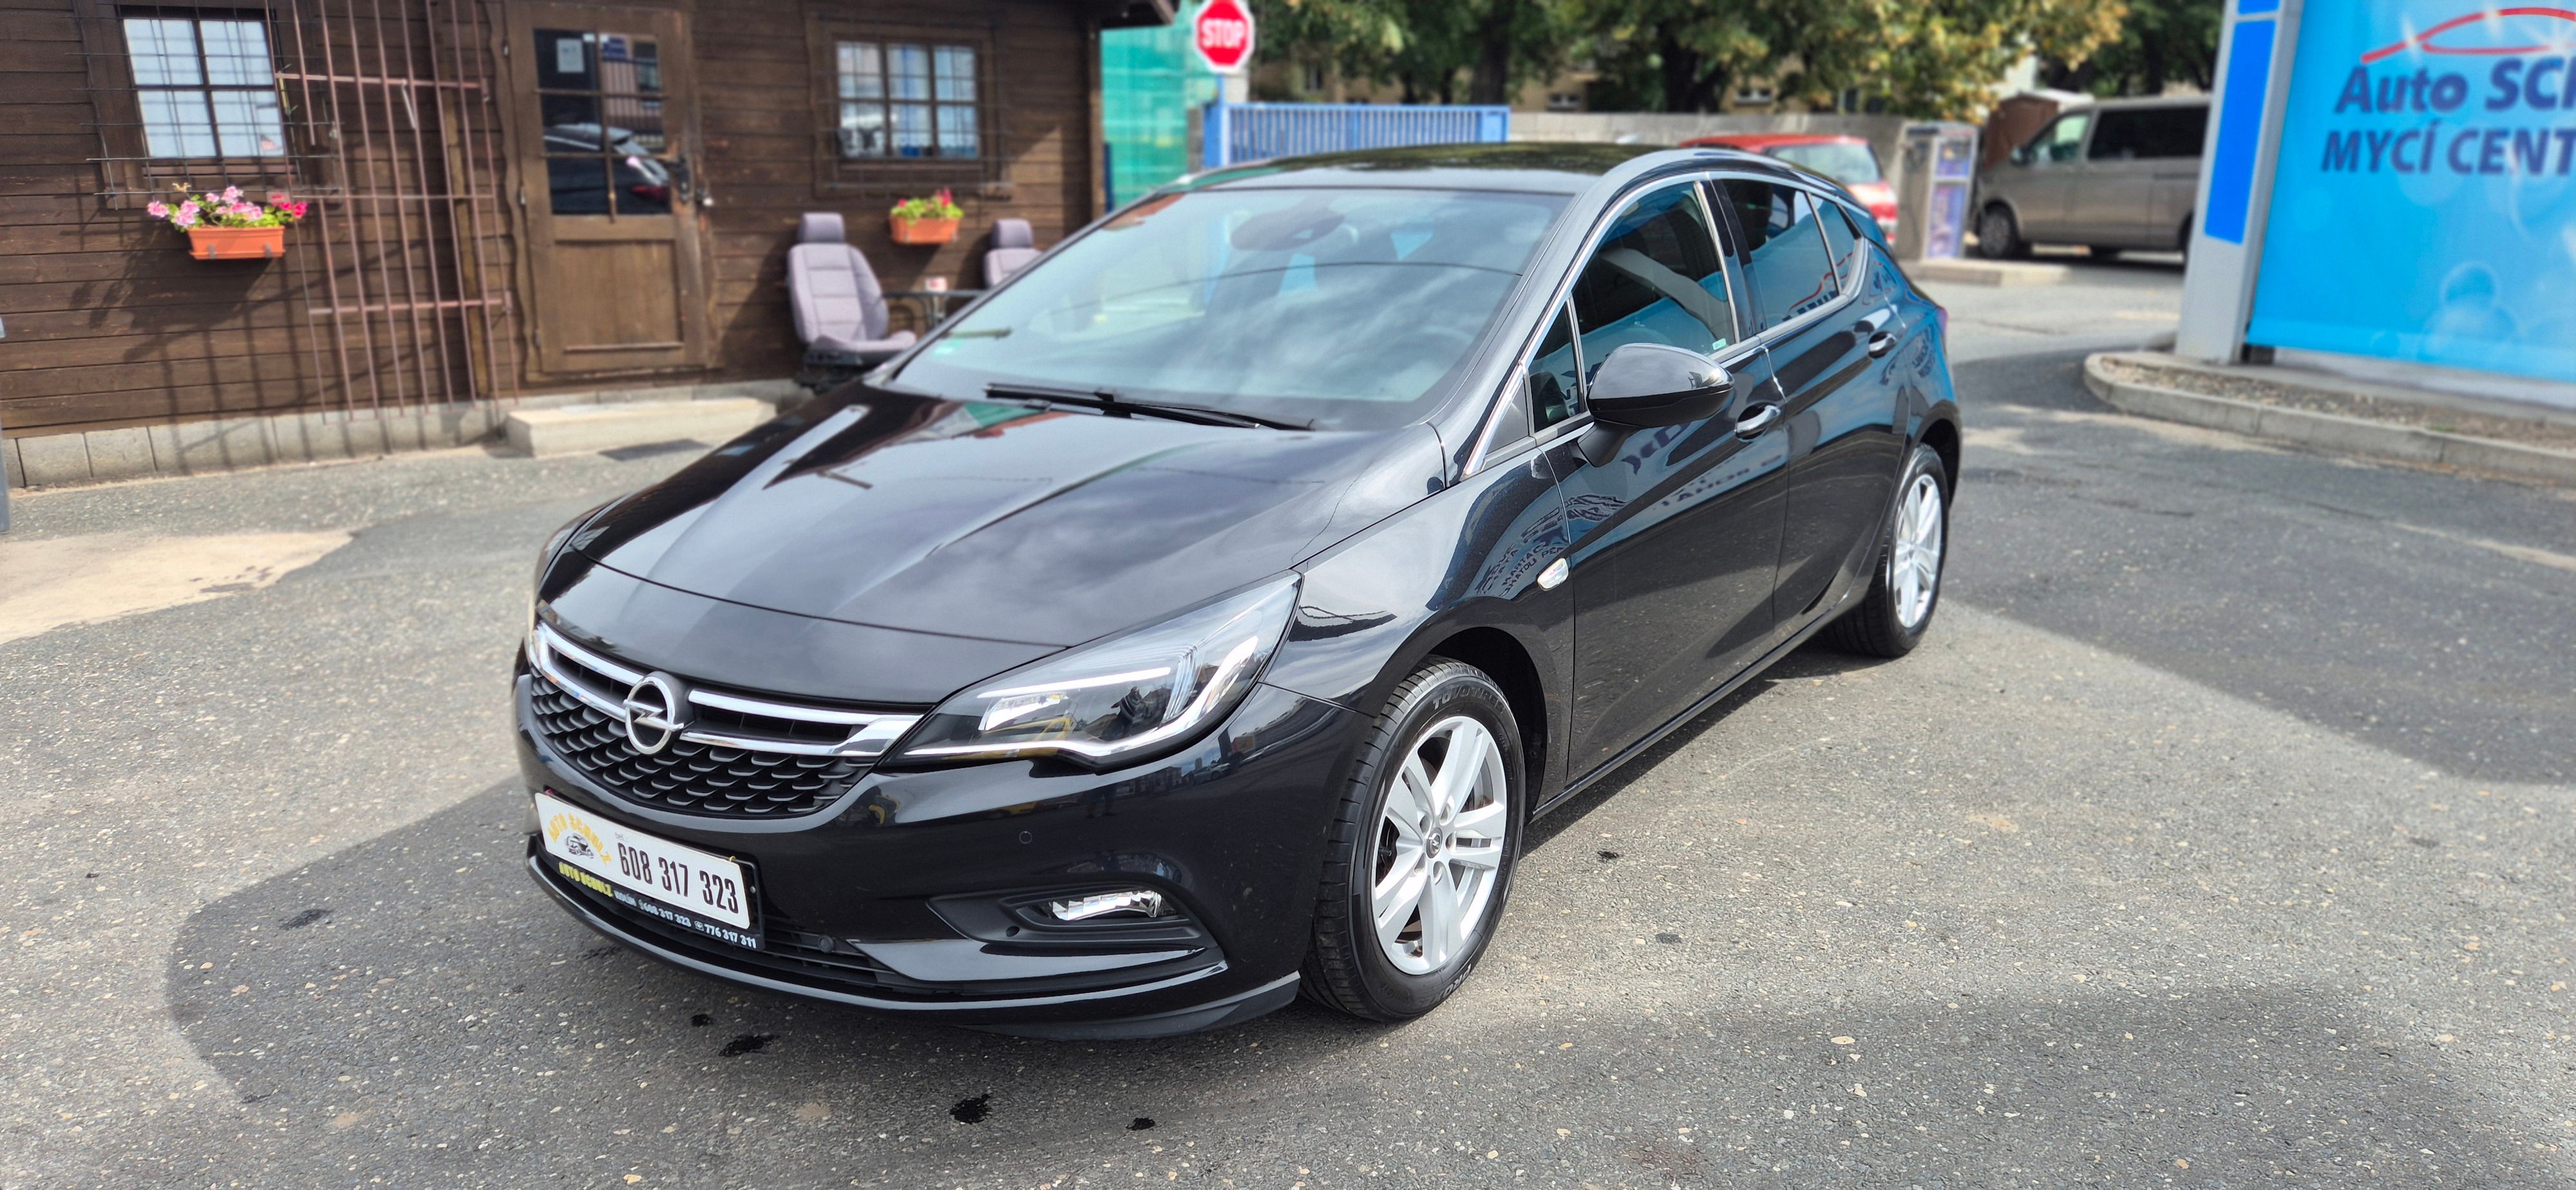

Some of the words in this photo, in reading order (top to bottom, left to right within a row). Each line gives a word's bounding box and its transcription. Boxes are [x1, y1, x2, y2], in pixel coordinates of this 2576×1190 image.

[1202, 19, 1245, 47] STOP
[2333, 65, 2468, 114] Auto
[2320, 120, 2441, 174] MYCÍ
[1433, 685, 1471, 710] TOYO
[617, 842, 653, 885] 608
[658, 856, 688, 898] 317
[699, 870, 739, 914] 323
[658, 908, 674, 921] 317
[674, 913, 692, 927] 323
[703, 923, 722, 938] 776
[722, 929, 738, 944] 317
[739, 934, 757, 949] 311
